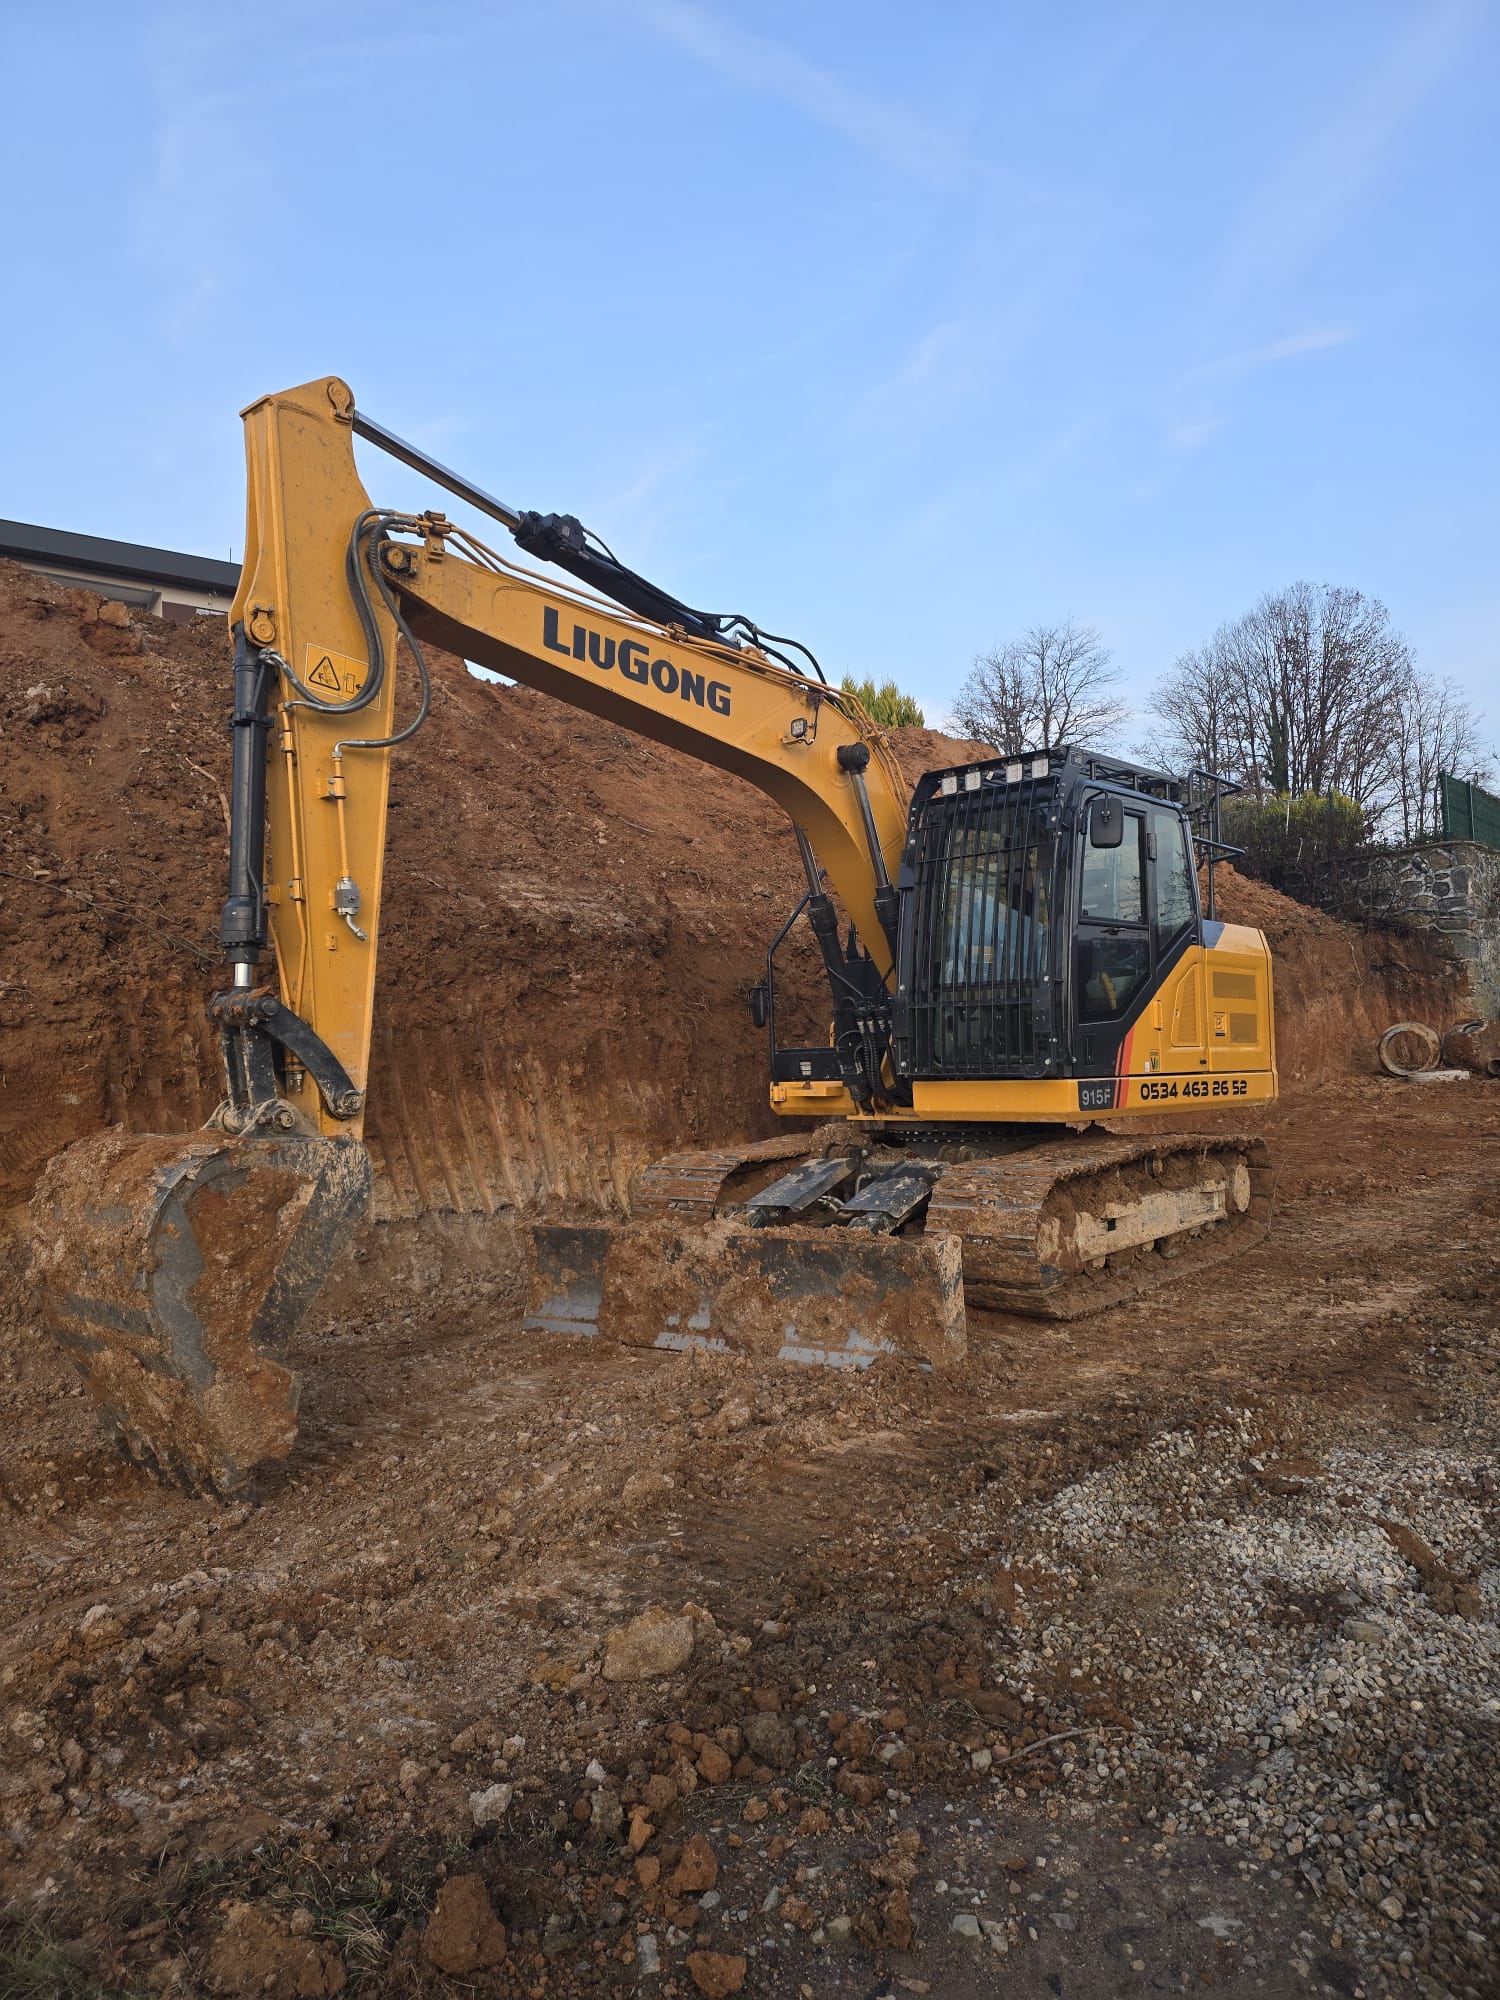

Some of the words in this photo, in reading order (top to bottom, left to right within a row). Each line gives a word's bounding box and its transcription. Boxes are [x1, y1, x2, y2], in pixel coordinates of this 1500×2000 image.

[1082, 1087, 1111, 1106] 915F
[1140, 1082, 1178, 1101] 0534
[1182, 1081, 1209, 1098] 463
[1212, 1080, 1229, 1096] 26
[1232, 1079, 1248, 1095] 52
